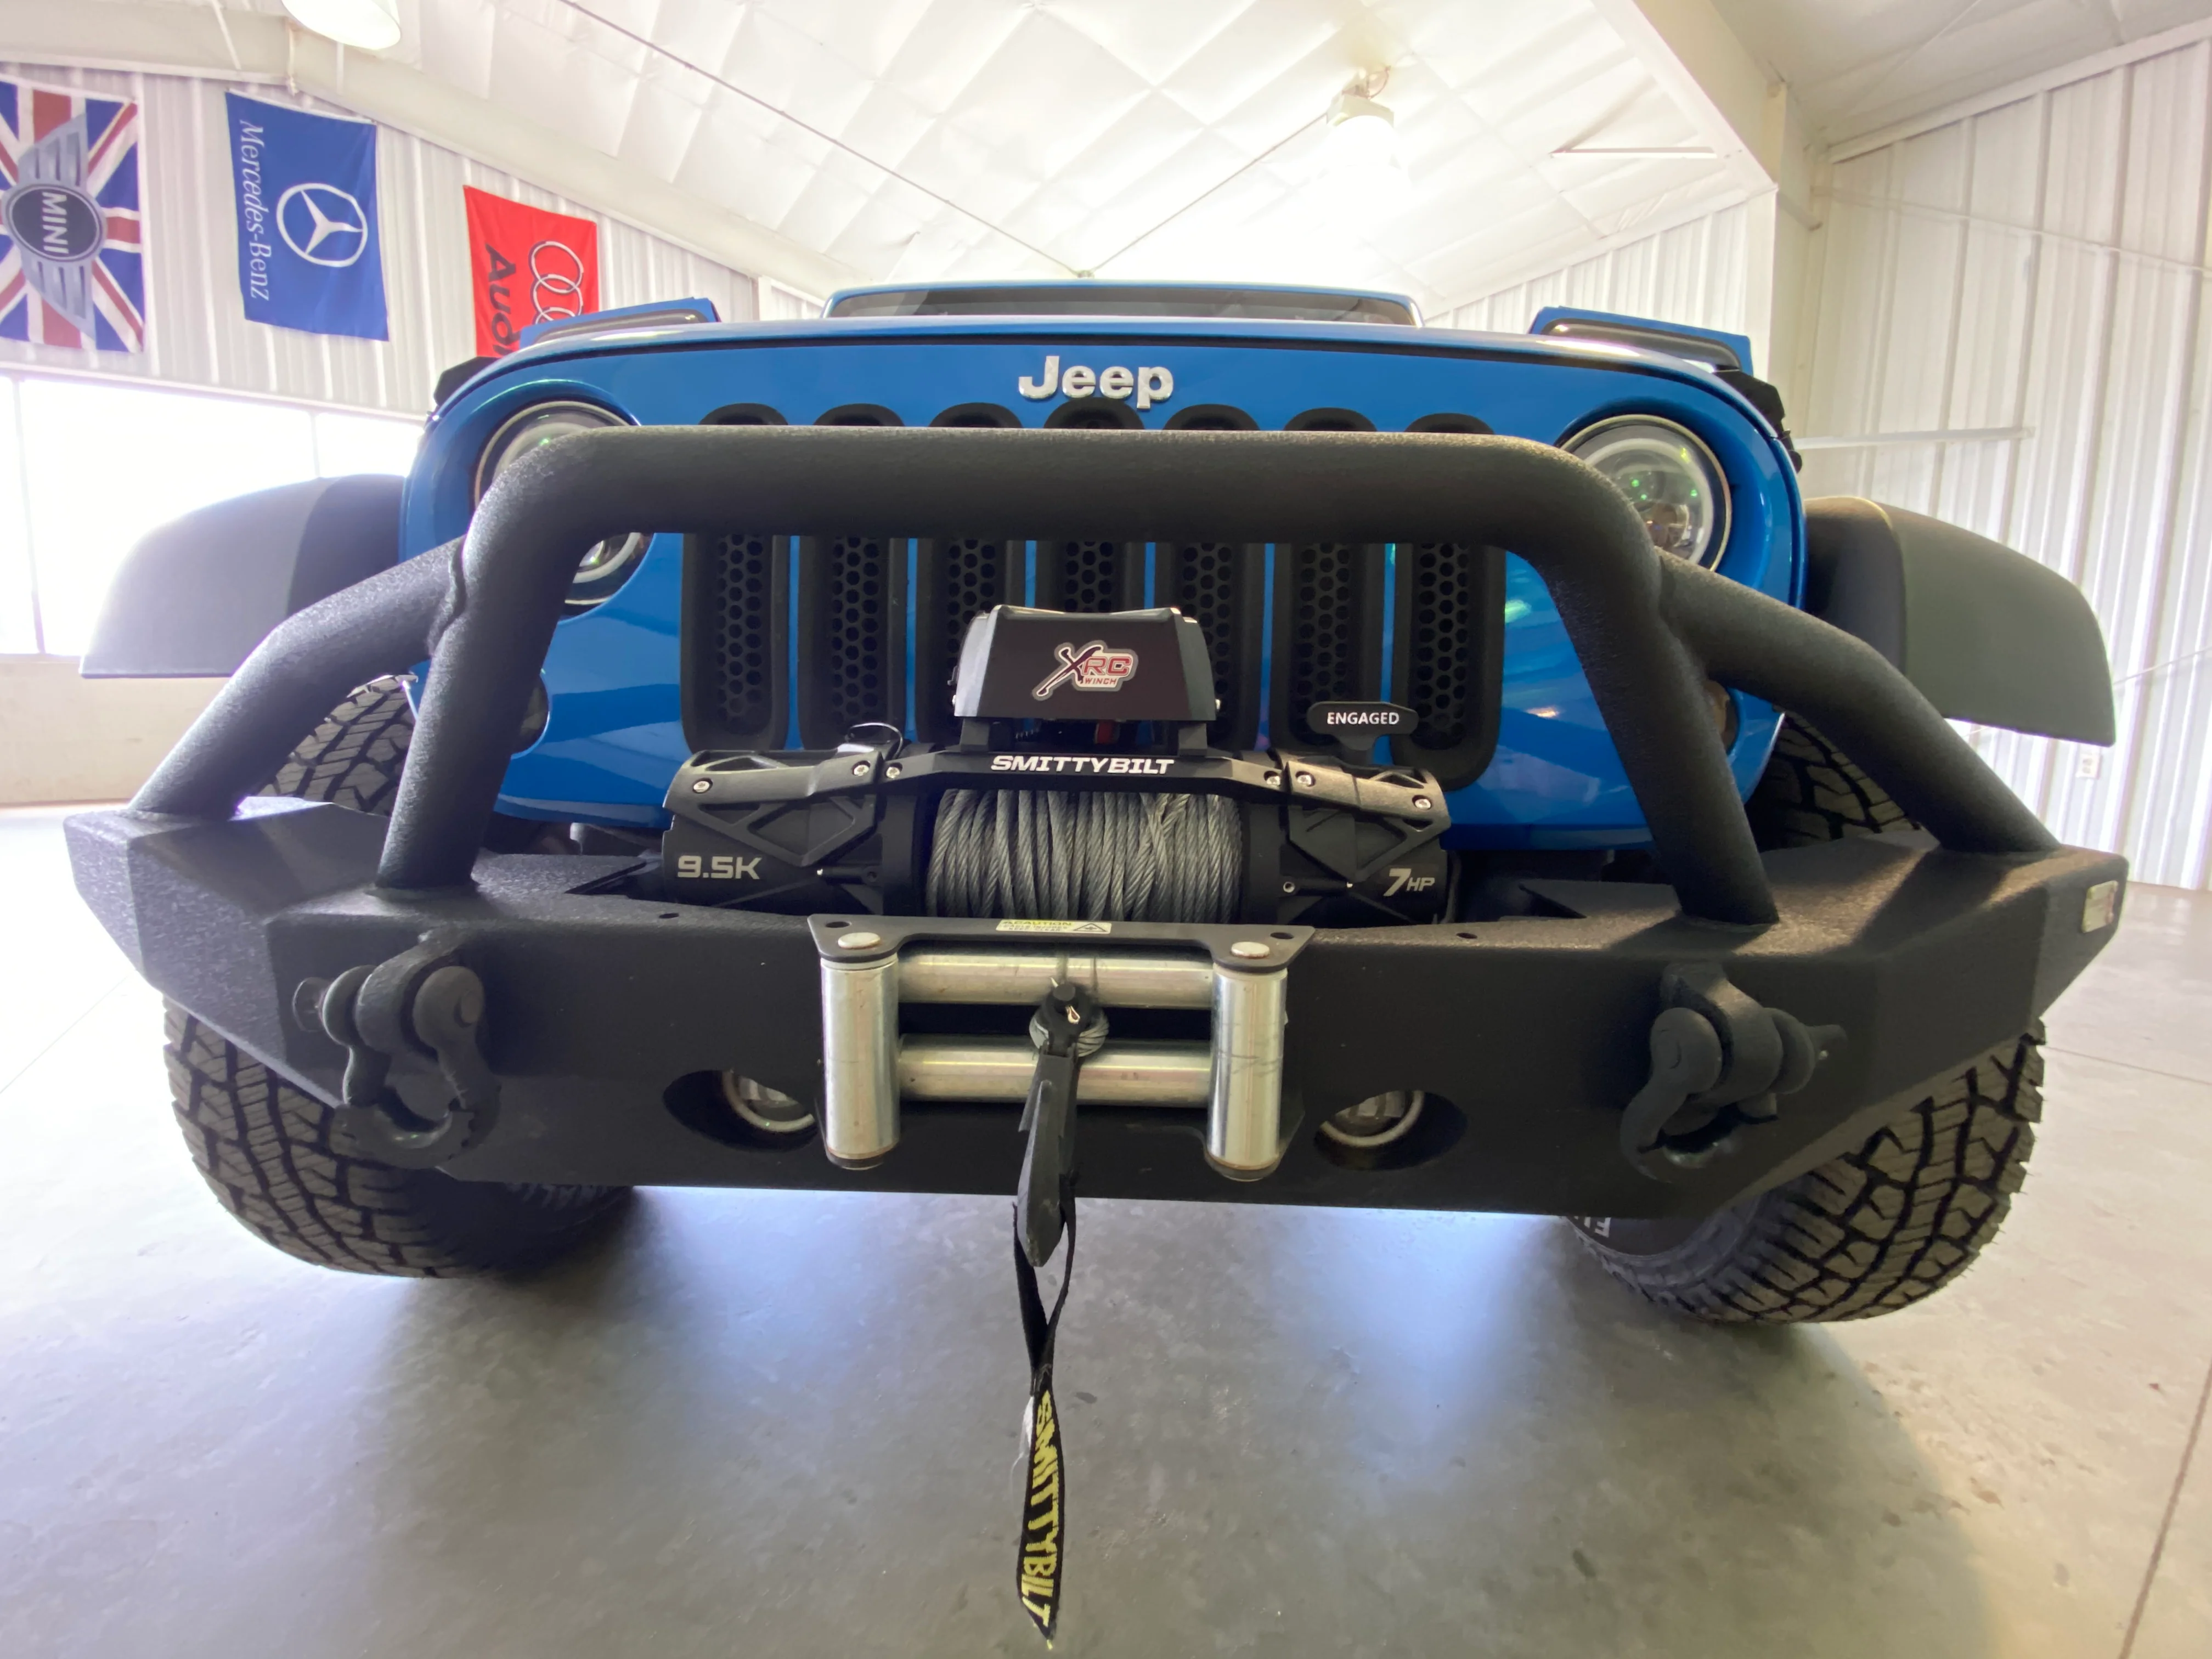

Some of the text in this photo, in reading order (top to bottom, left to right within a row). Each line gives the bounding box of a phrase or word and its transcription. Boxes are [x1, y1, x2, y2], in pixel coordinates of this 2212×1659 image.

[42, 191, 69, 254] MINI
[240, 119, 272, 301] Mercedes-Benz
[1018, 356, 1174, 409] Jeep
[1036, 644, 1133, 697] XRC
[1084, 677, 1117, 685] WINCH
[1327, 712, 1400, 725] ENGAGED
[991, 755, 1175, 775] SMITTYBILT
[678, 855, 763, 879] 9.5K
[1021, 1390, 1059, 1627] SMITTYBILT
